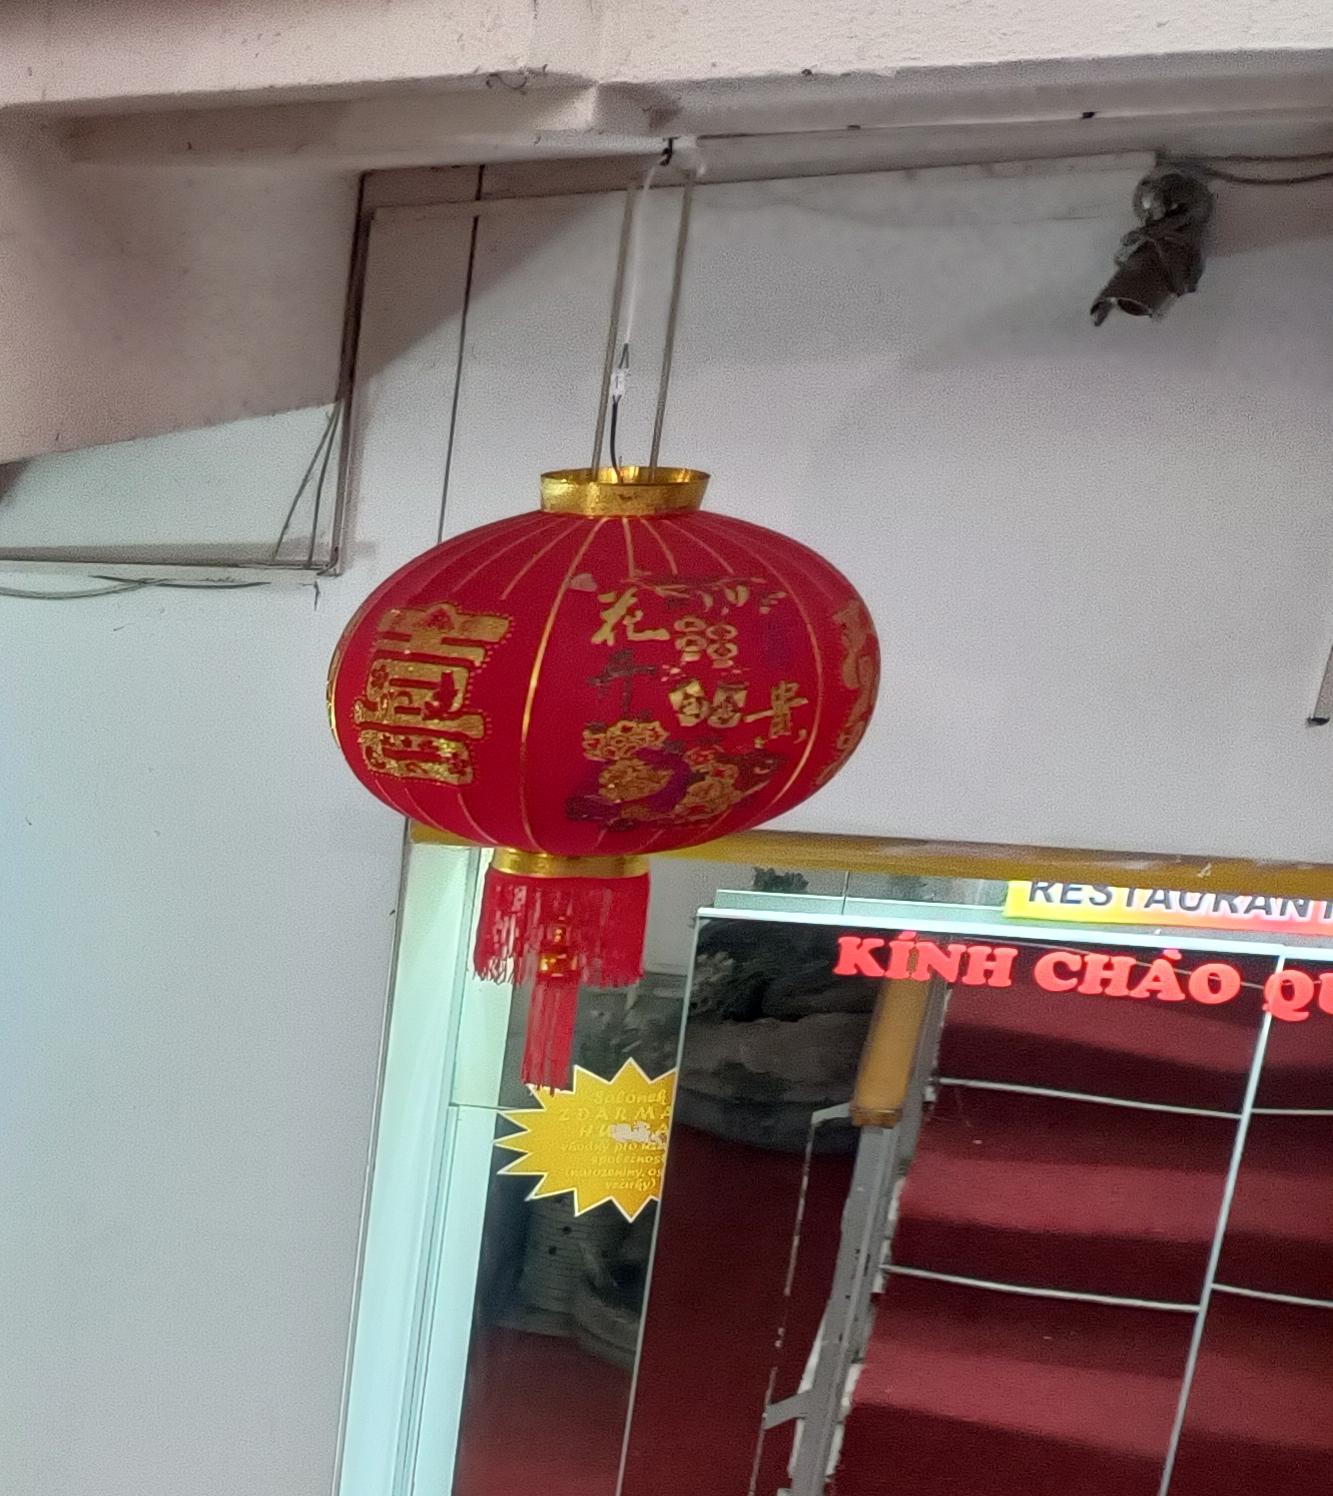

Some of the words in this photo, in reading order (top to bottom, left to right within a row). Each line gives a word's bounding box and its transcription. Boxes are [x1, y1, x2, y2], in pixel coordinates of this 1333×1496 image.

[1029, 881, 1333, 920] RESTAURAN
[834, 930, 1018, 987] KÍNH
[1034, 948, 1242, 1005] CHÀO
[580, 1123, 669, 1137] HUA
